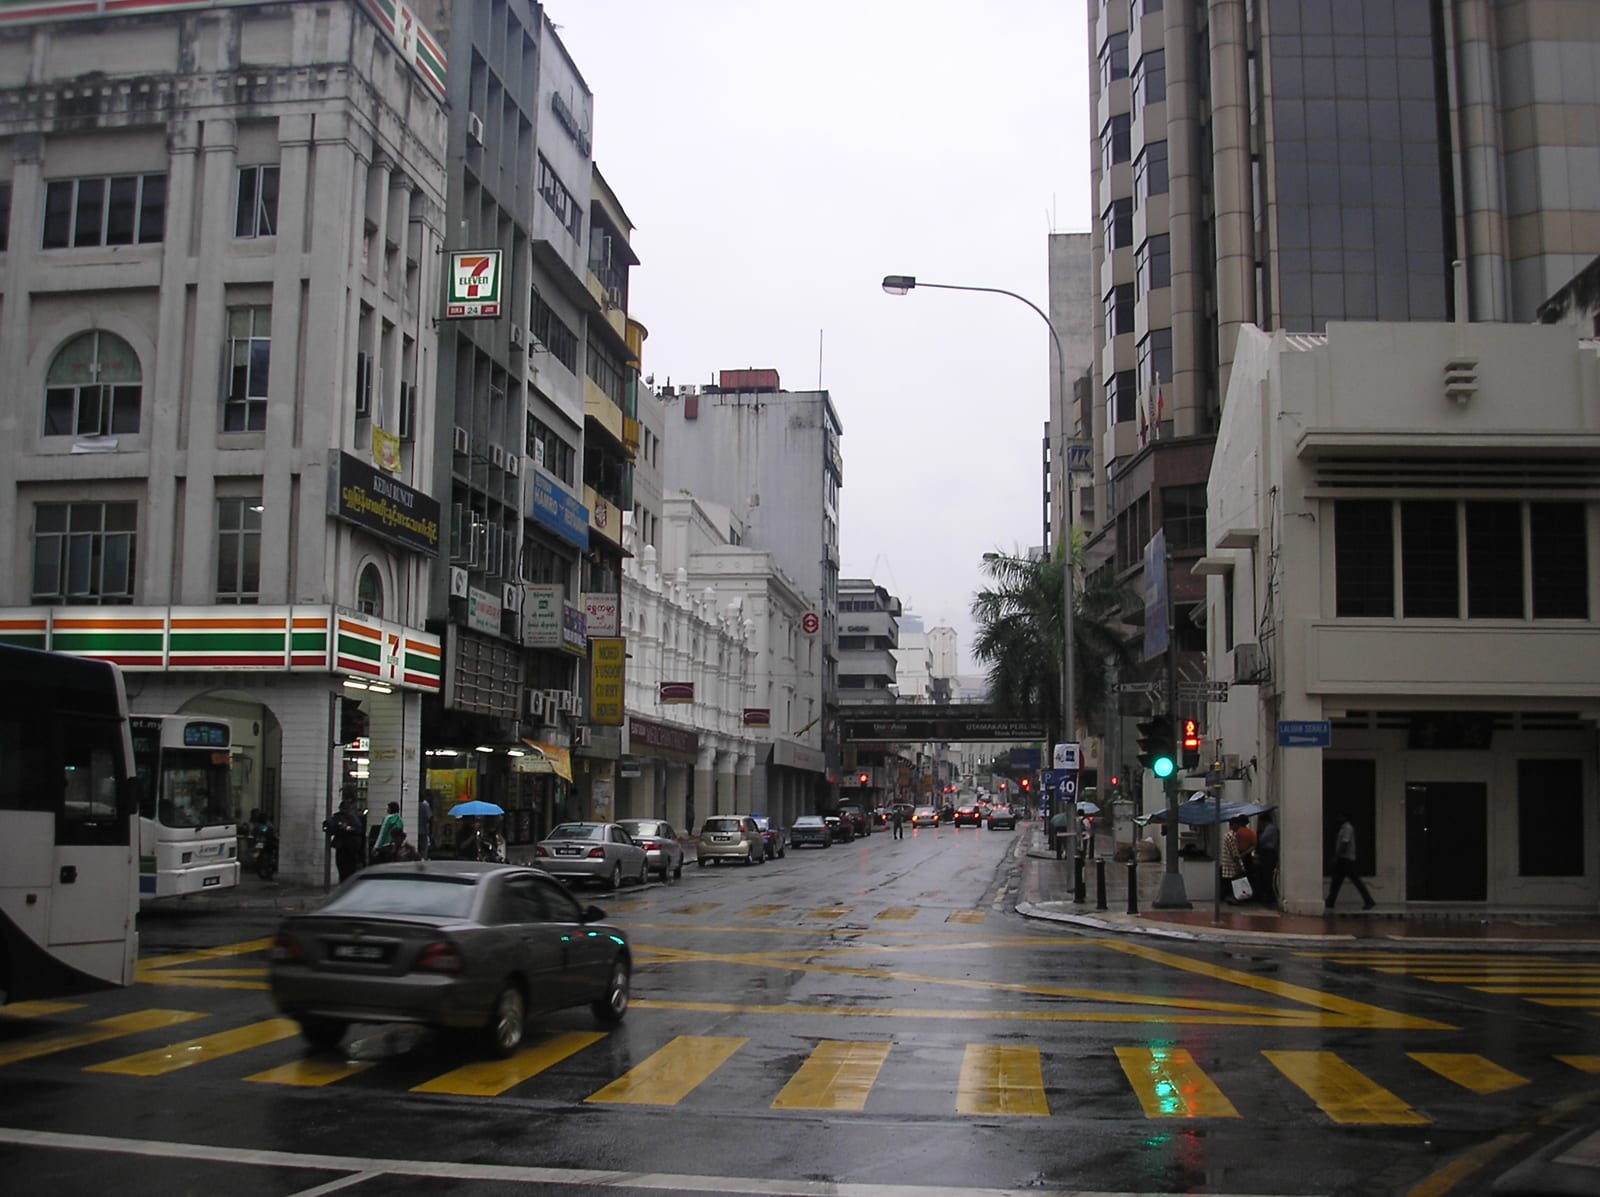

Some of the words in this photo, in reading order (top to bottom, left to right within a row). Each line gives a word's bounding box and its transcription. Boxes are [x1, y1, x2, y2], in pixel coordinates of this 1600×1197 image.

[460, 256, 490, 297] 7
[467, 306, 478, 315] 24
[388, 633, 400, 679] 7
[1059, 780, 1075, 793] 40
